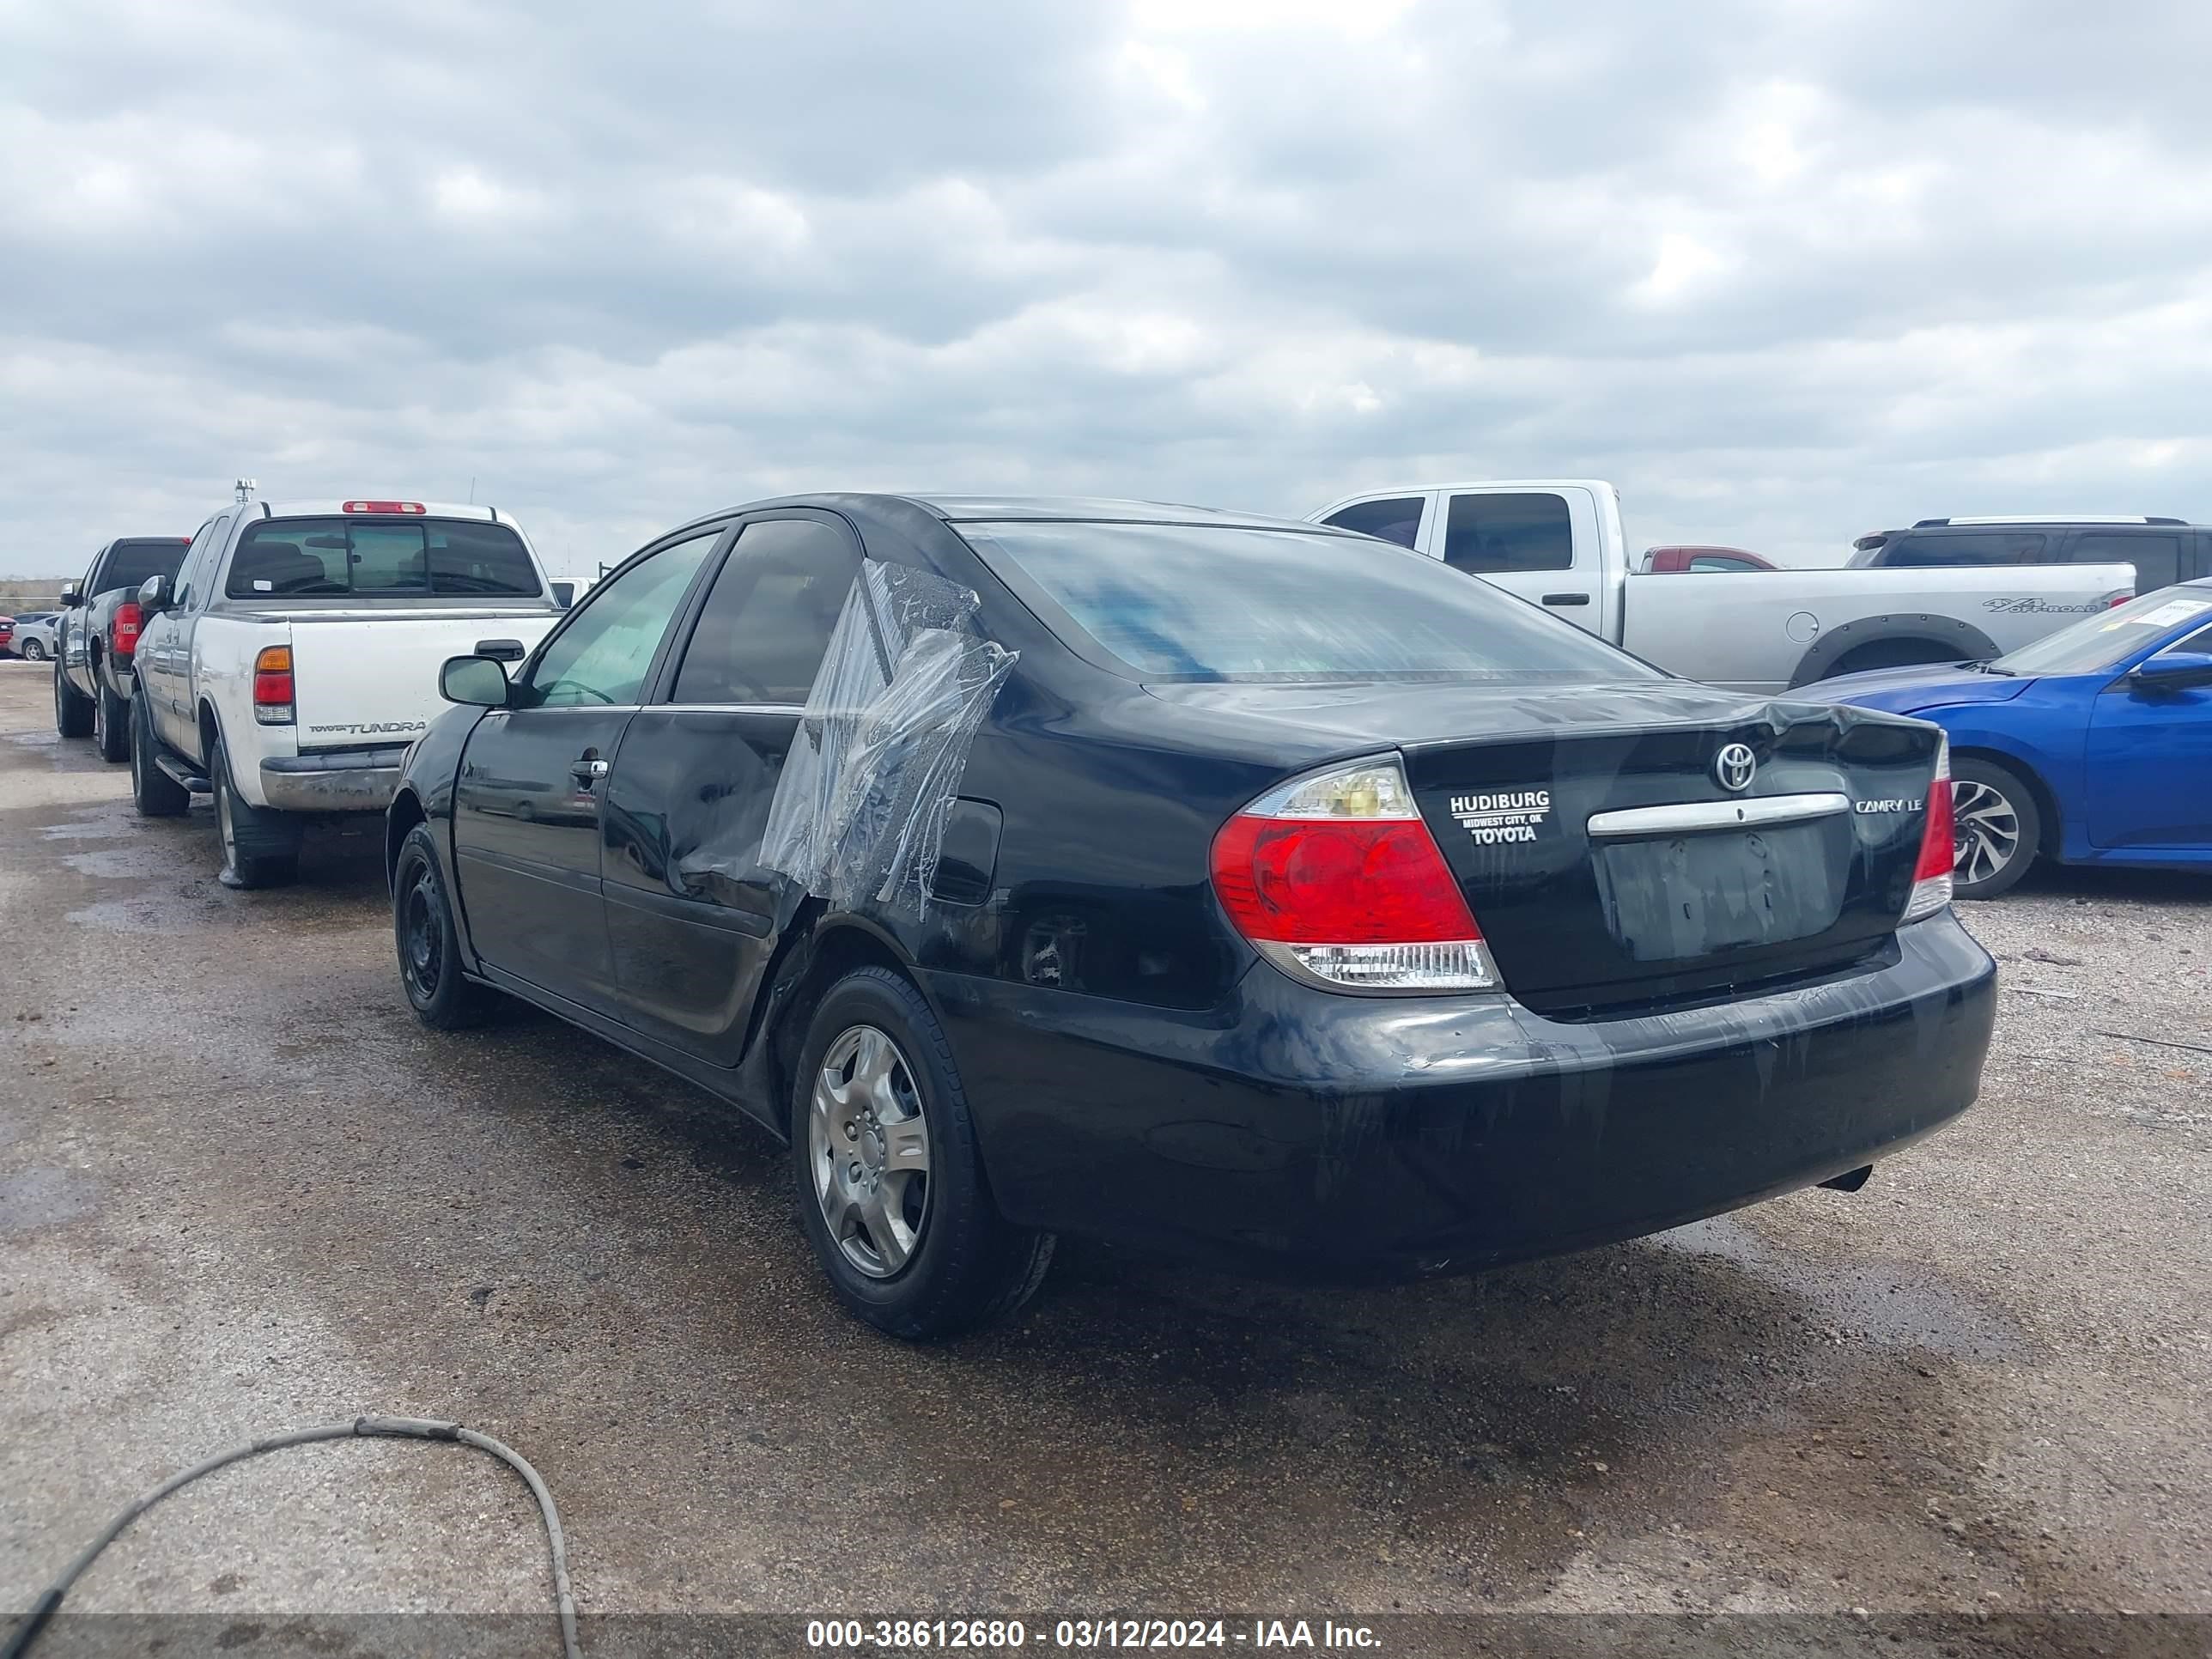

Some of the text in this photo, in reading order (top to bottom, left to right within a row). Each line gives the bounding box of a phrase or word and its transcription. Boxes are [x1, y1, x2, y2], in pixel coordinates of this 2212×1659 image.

[2008, 605, 2099, 613] OFF-ROAD
[345, 720, 427, 734] TUNDRA
[1450, 791, 1549, 811] HUDIBURG
[1855, 799, 1923, 814] CAMRY LE
[1463, 814, 1542, 828] MIDWEST CITY, OK
[1471, 826, 1536, 845] TOYOTA
